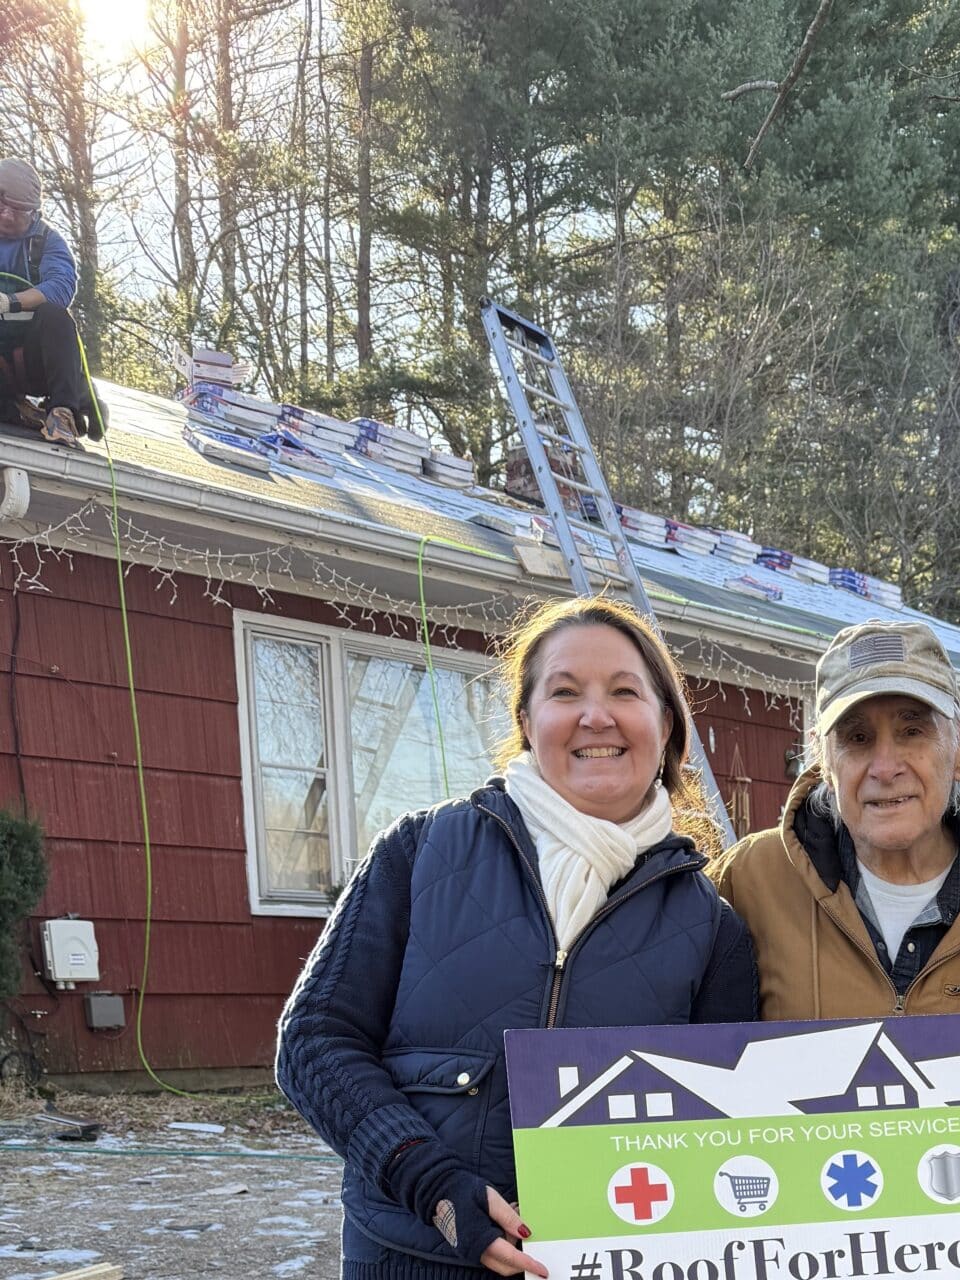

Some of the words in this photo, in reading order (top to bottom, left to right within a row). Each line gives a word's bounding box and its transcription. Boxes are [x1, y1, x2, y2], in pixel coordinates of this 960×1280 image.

[610, 1132, 689, 1152] THANK
[694, 1129, 741, 1148] YOU
[749, 1127, 794, 1145] FOR
[800, 1123, 863, 1141] YOUR
